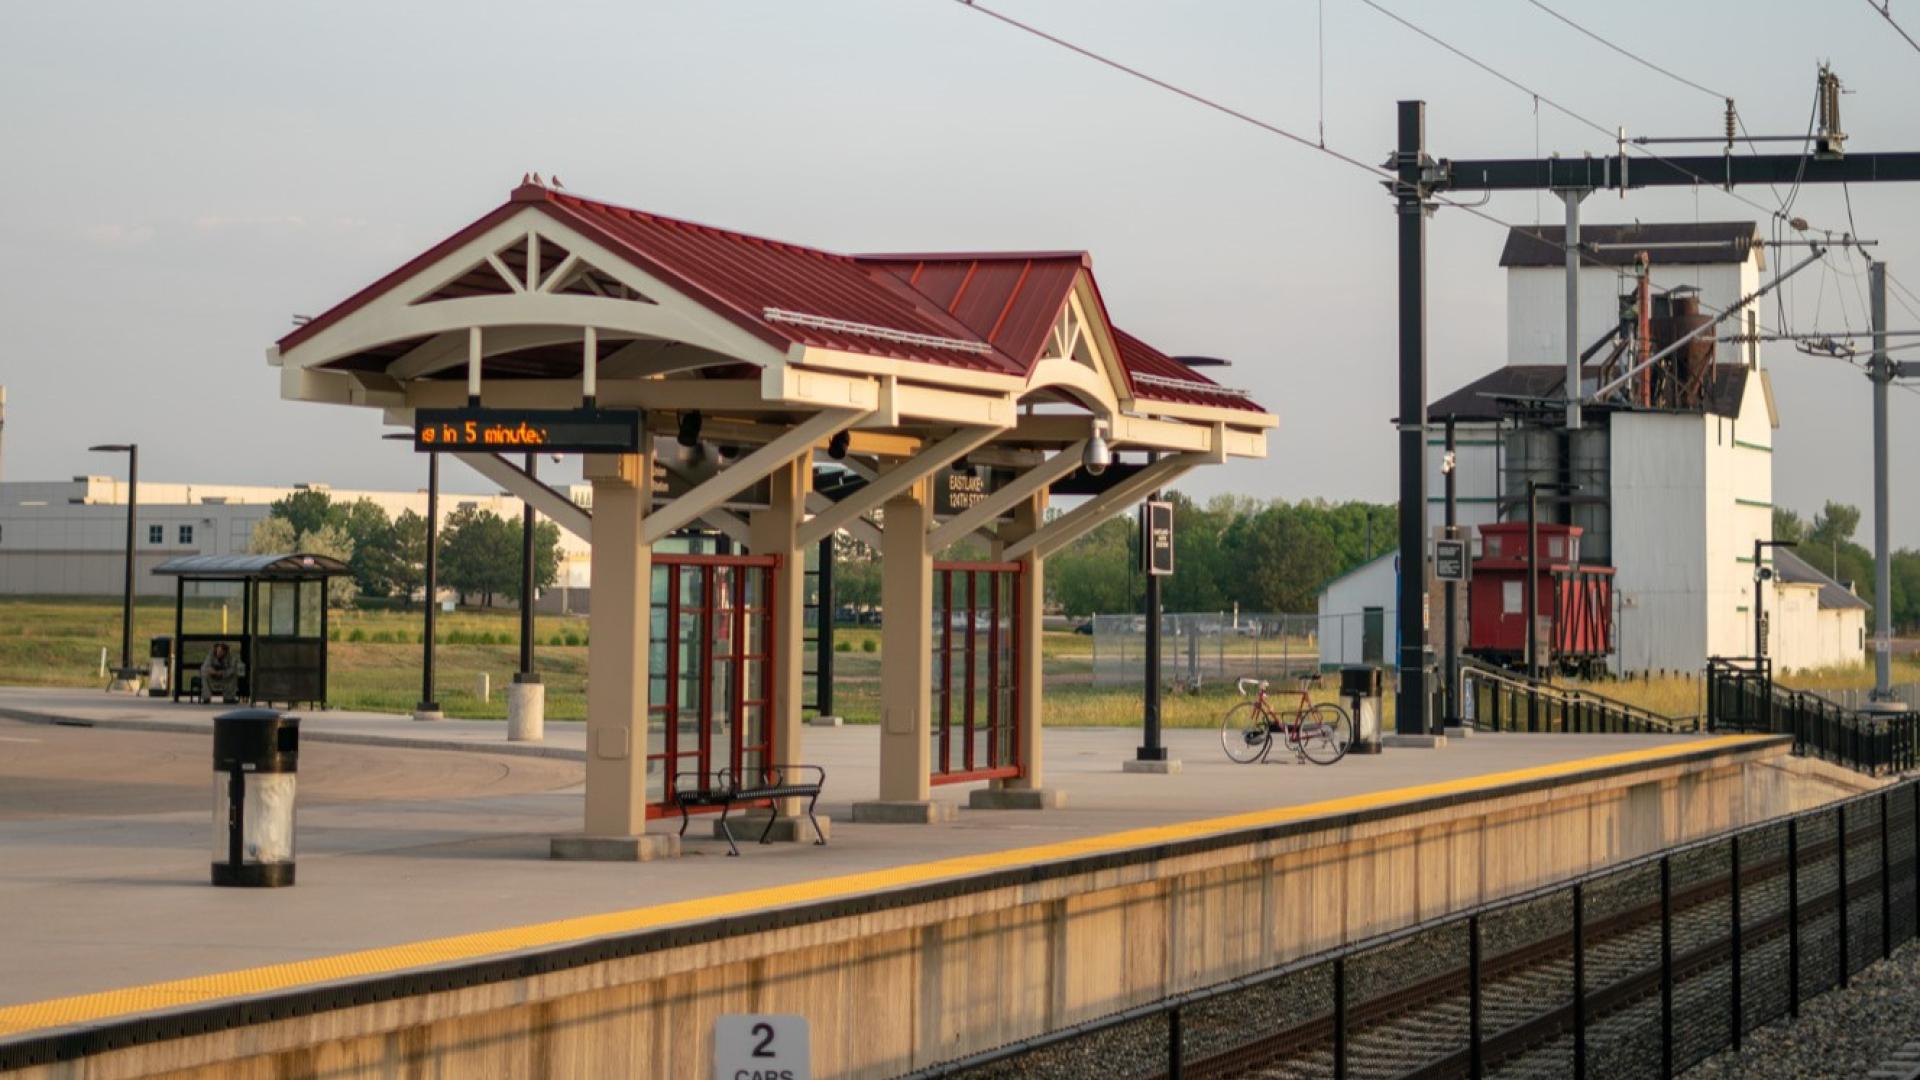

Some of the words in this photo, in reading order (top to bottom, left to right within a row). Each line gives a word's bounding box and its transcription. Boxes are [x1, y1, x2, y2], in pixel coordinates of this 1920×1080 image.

[443, 424, 458, 443] in
[464, 421, 477, 443] 5
[751, 1022, 776, 1058] 2
